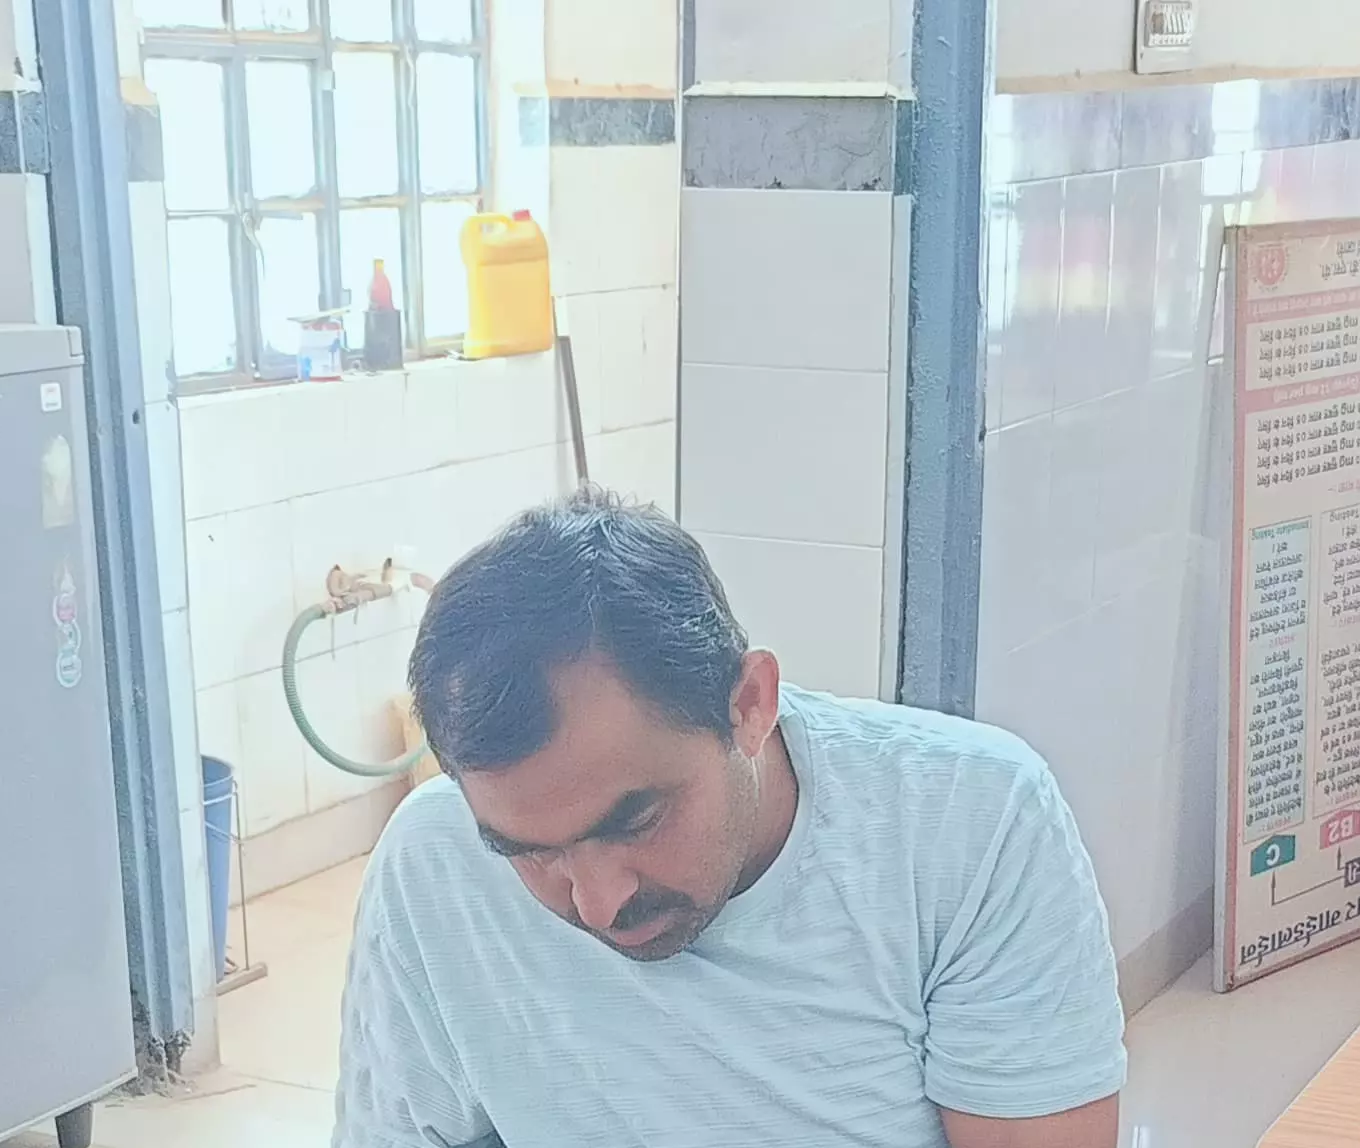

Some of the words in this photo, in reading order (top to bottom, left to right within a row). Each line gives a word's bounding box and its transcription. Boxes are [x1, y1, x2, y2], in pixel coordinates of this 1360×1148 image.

[1329, 506, 1359, 523] Testing
[1328, 816, 1353, 841] B2
[1266, 844, 1280, 865] C
[1240, 909, 1340, 967] गाईडलाईन
